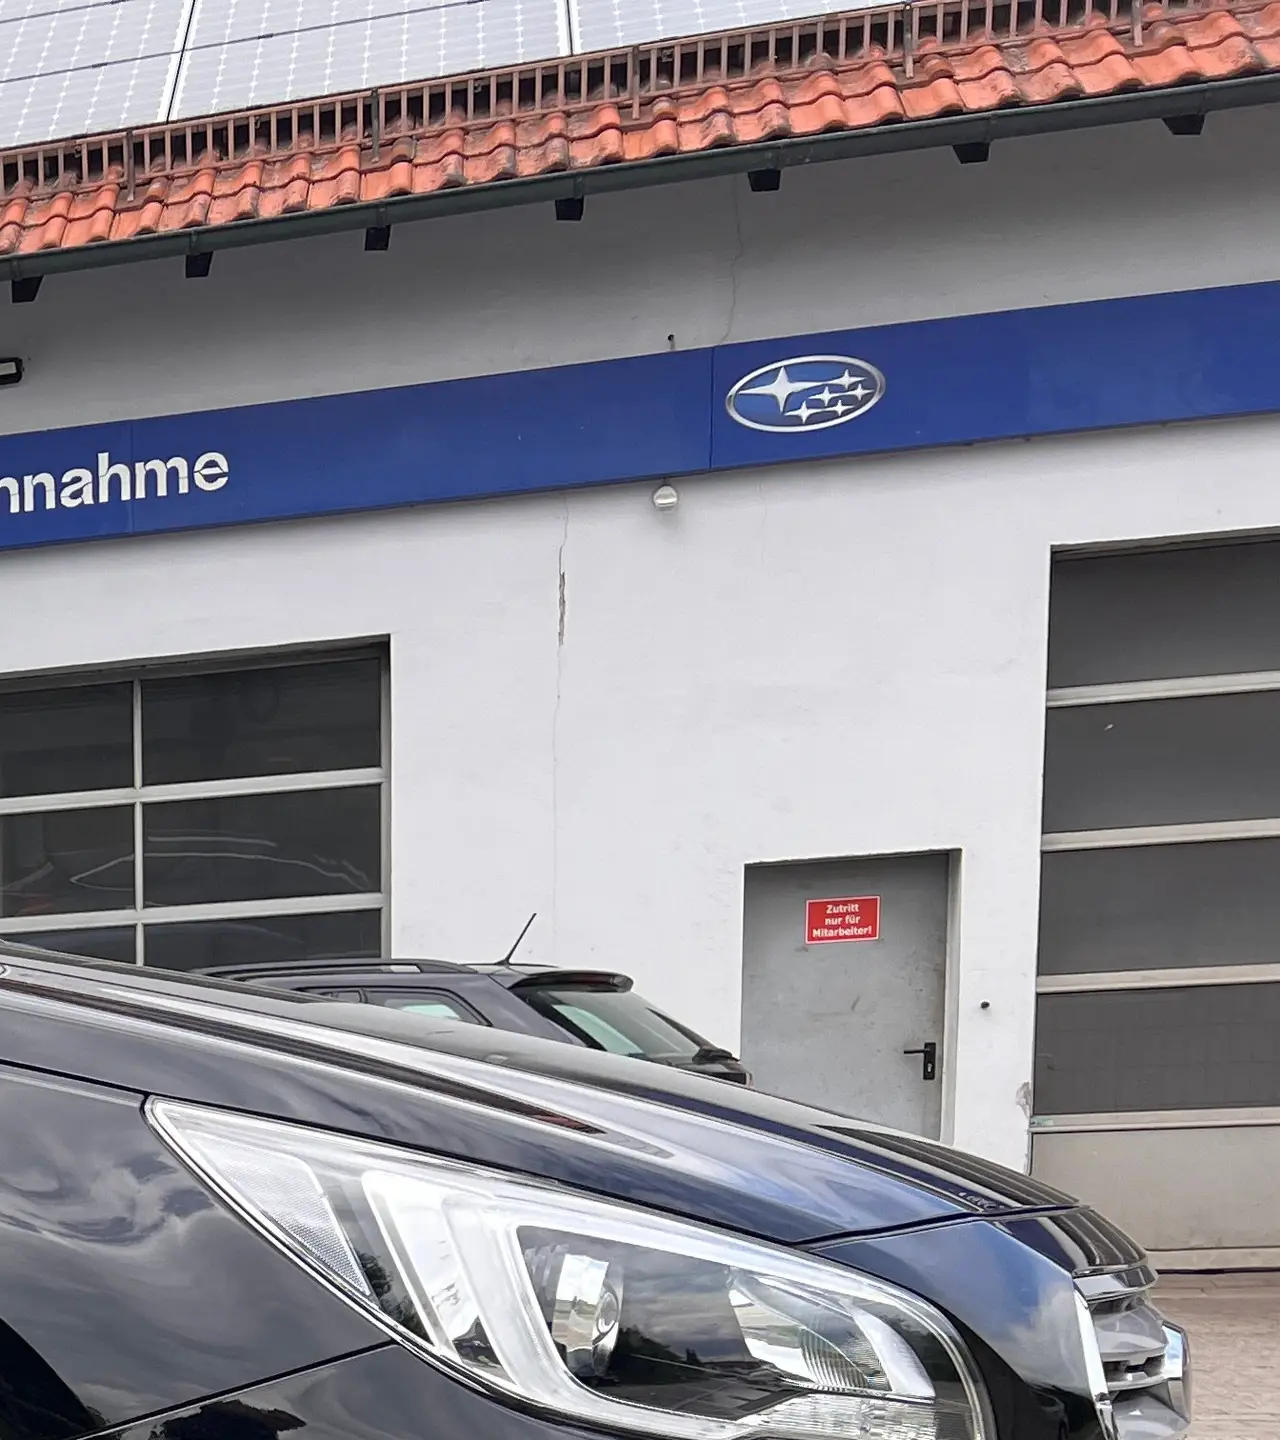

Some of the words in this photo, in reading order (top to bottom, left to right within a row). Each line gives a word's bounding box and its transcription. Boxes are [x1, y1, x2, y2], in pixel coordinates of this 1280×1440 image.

[826, 903, 860, 914] Zutritt
[824, 916, 842, 926] nur
[845, 914, 861, 925] für
[812, 925, 872, 938] Mitarbeiter!
